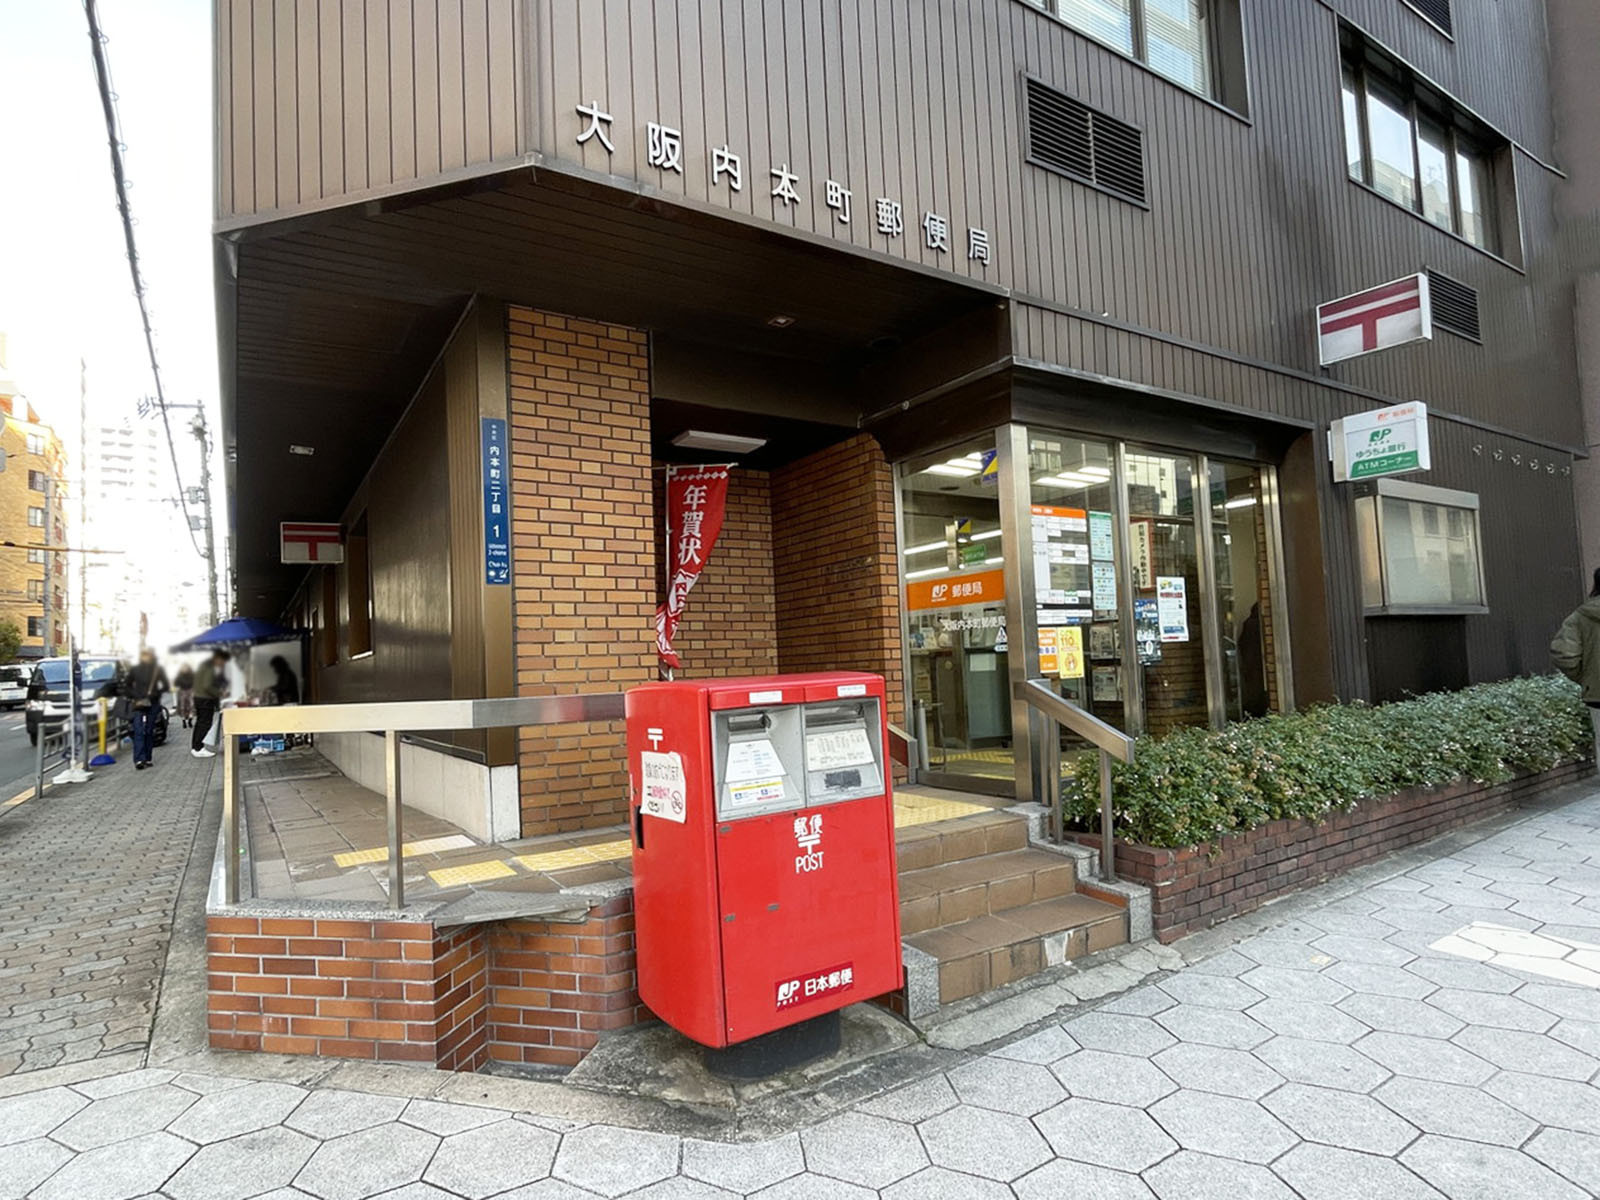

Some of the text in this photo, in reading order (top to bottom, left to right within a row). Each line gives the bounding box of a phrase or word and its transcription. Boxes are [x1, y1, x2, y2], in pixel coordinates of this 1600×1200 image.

[576, 100, 990, 265] 大阪内本町郵便局
[1355, 443, 1406, 458] ゆうちょ銀行
[1358, 456, 1412, 470] ATMコーナー
[492, 524, 500, 538] 1
[678, 484, 708, 566] 年賀状
[795, 851, 825, 874] POST
[804, 967, 853, 997] 日本郵便
